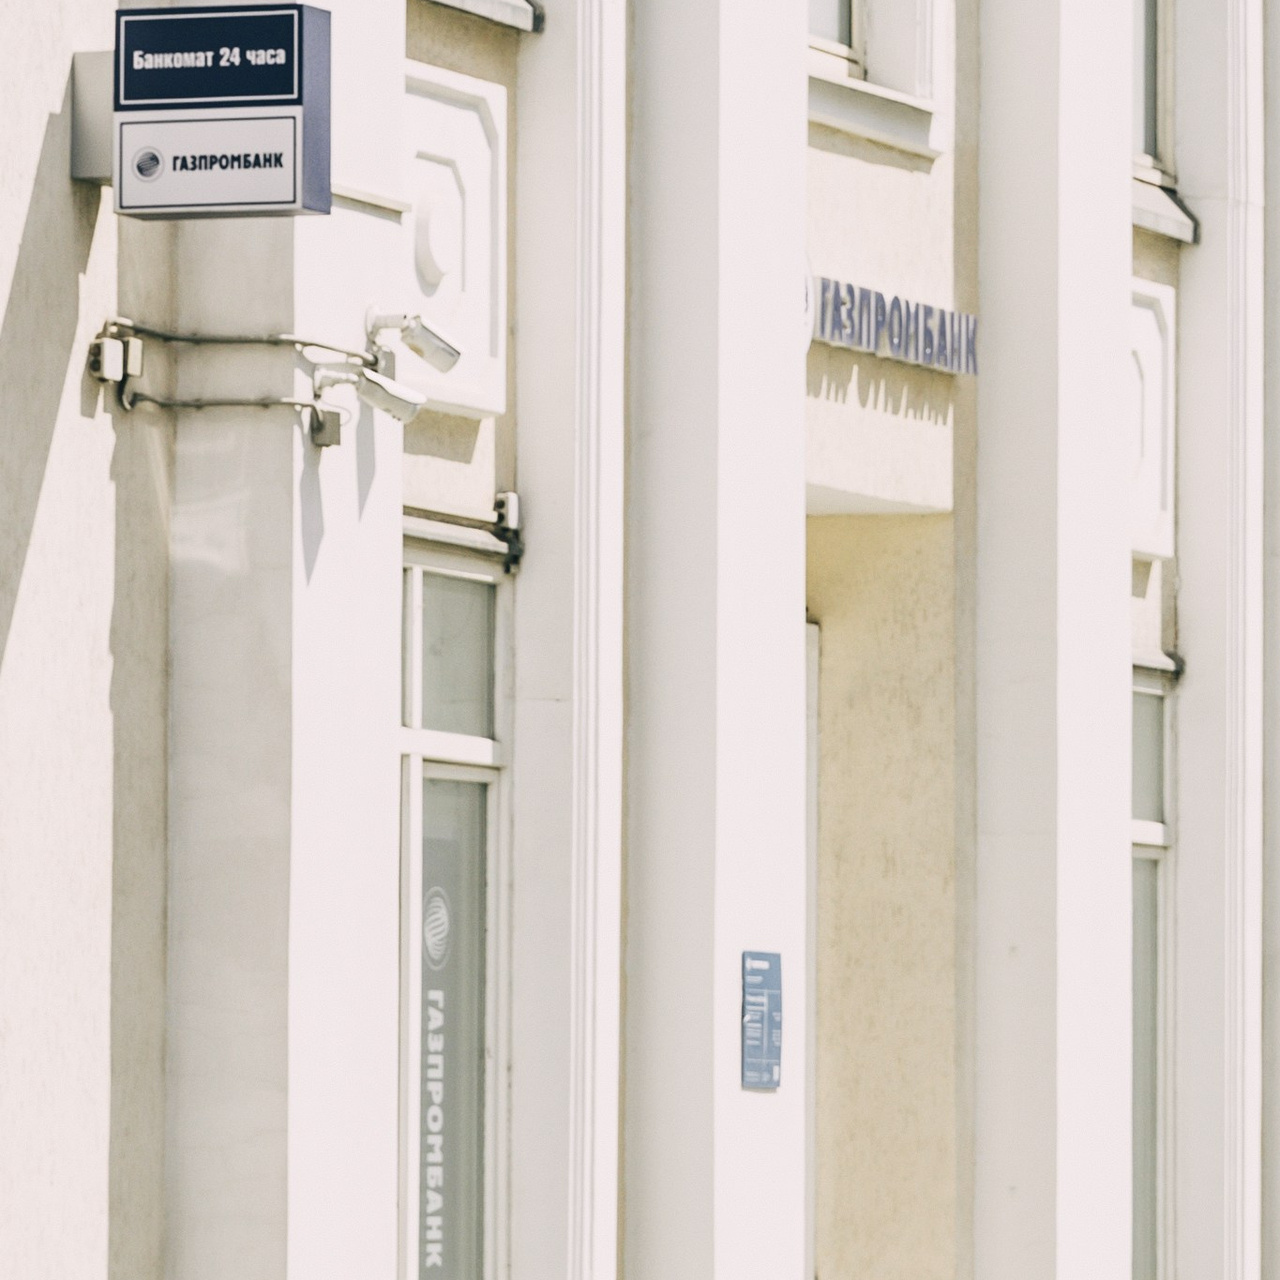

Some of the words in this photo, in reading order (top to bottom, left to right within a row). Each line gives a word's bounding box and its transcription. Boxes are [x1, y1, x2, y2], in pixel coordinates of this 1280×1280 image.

[132, 49, 214, 70] Банкомат
[219, 46, 241, 67] 24
[245, 48, 287, 66] часа
[172, 152, 283, 172] ГАЗПРОМБАНК
[819, 276, 979, 376] ГАЗПРОМБАНК
[425, 989, 445, 1267] ГАЗПРОМБАНК
